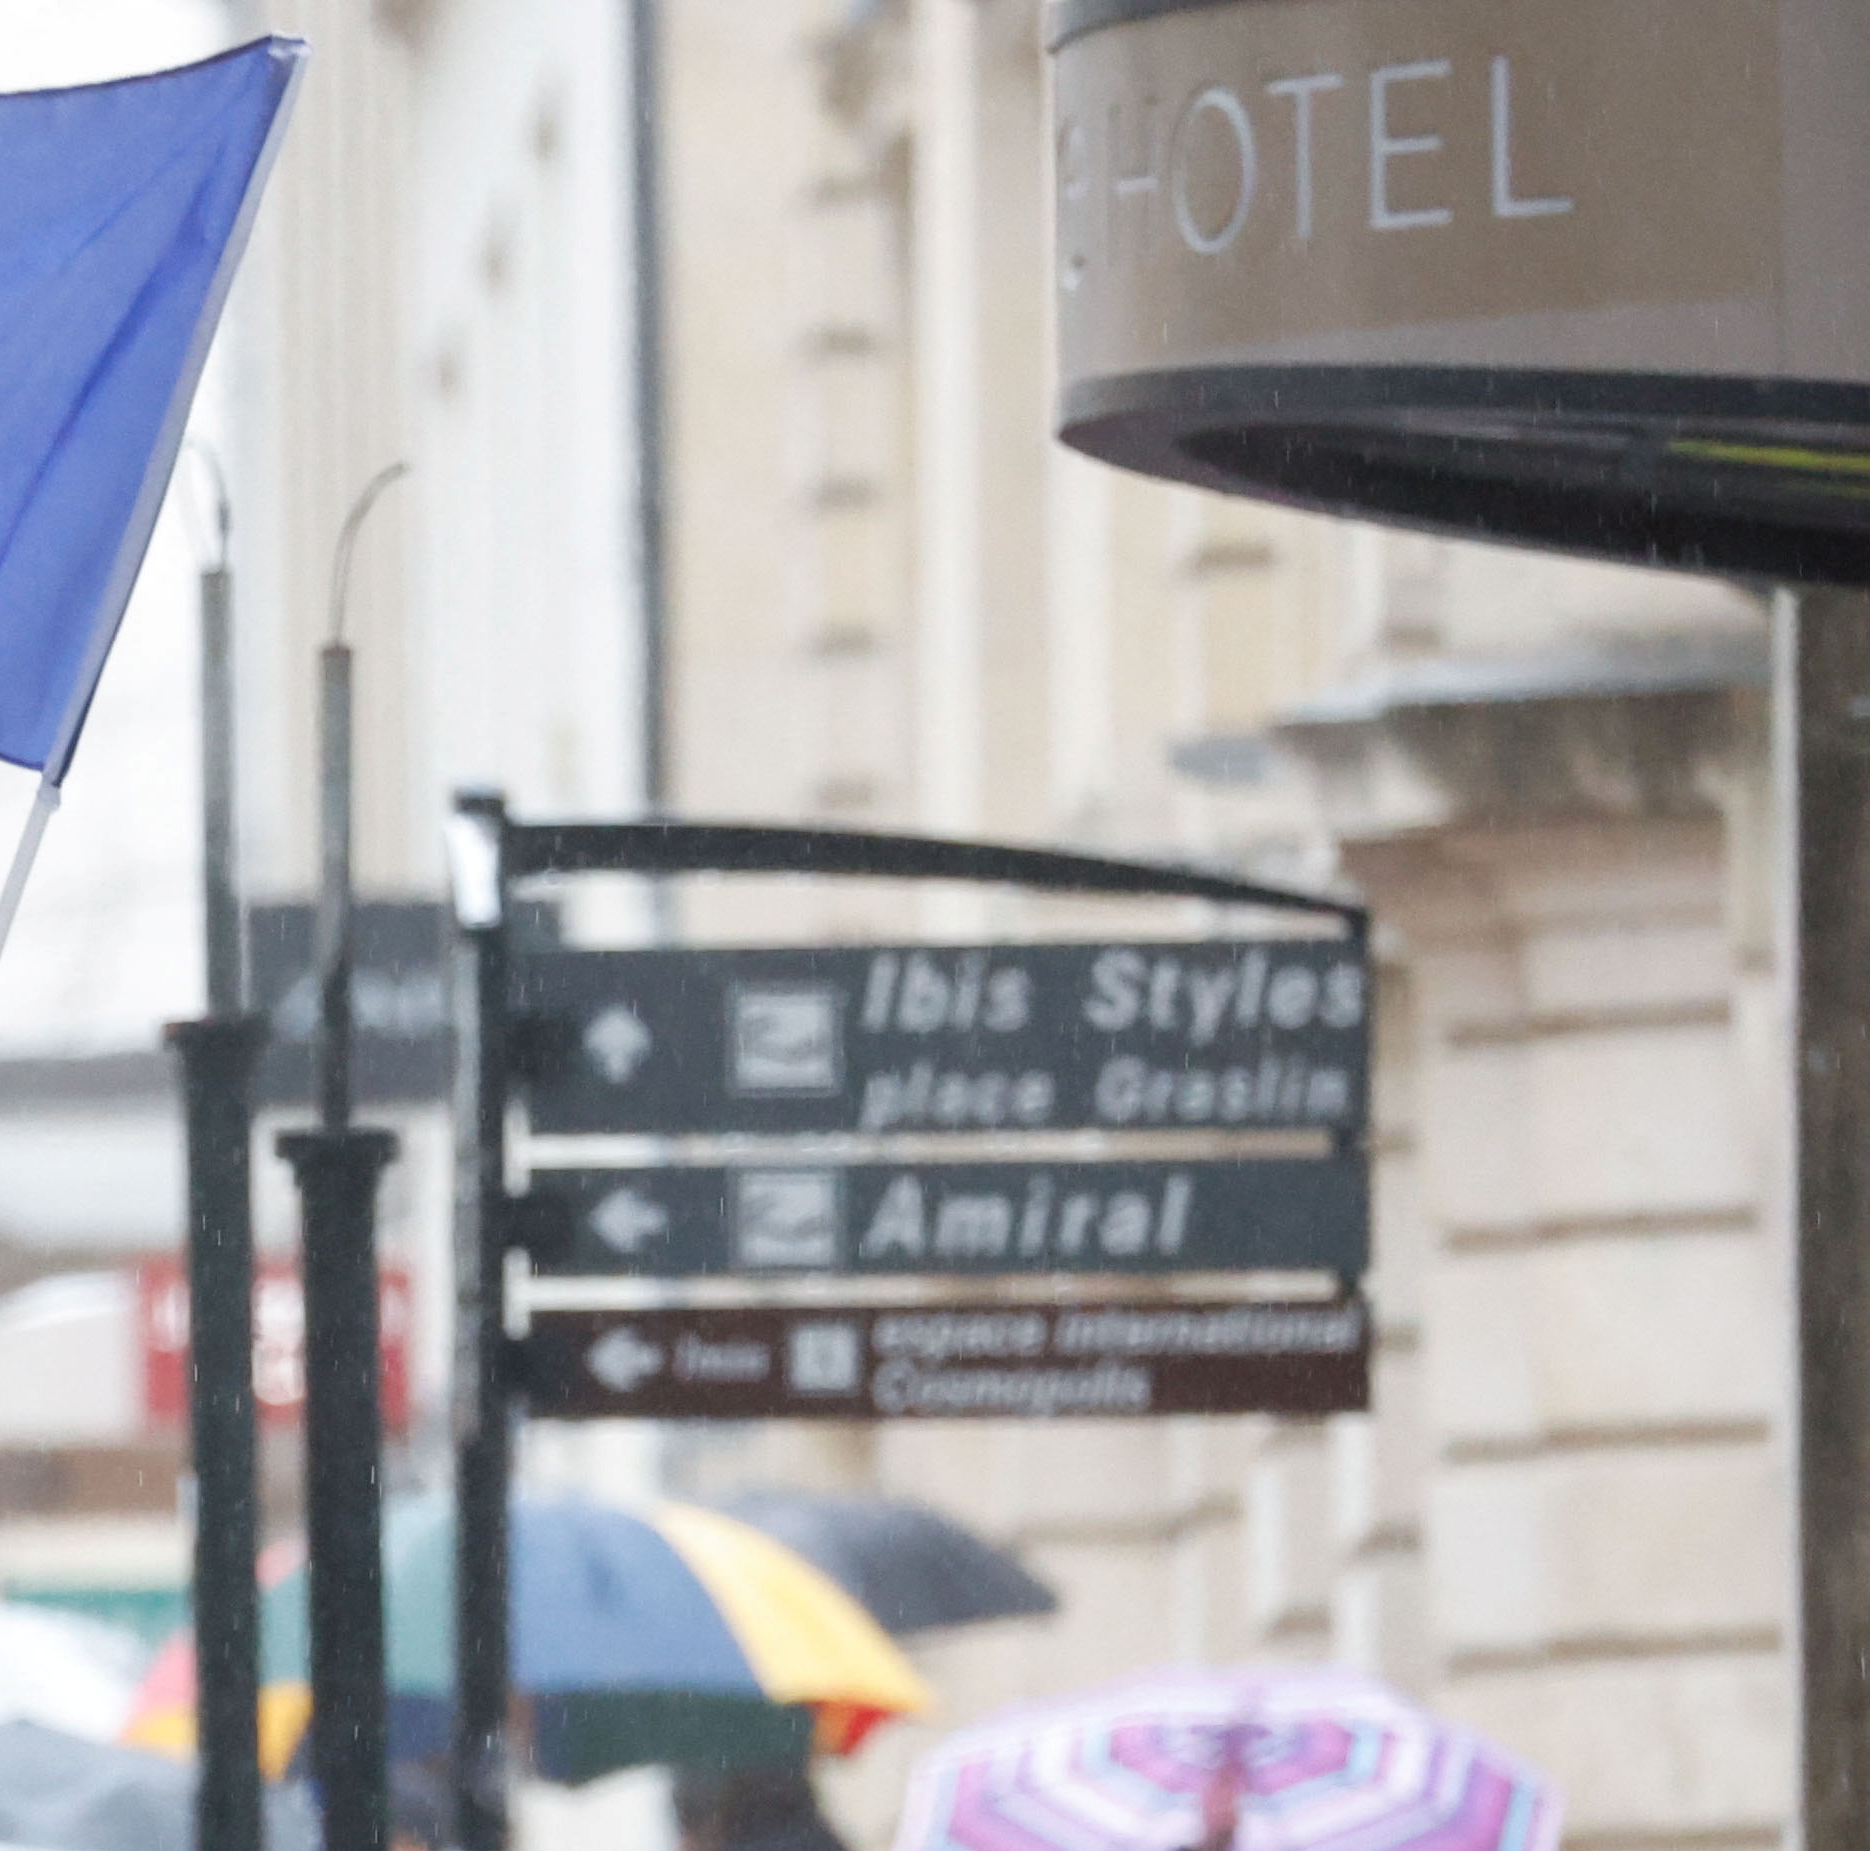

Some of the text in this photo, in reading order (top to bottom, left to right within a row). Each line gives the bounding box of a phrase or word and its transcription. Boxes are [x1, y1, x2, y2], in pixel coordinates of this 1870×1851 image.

[865, 948, 1364, 1044] Ibis Styles
[861, 1062, 1055, 1130] place
[864, 1175, 1193, 1260] Amiral
